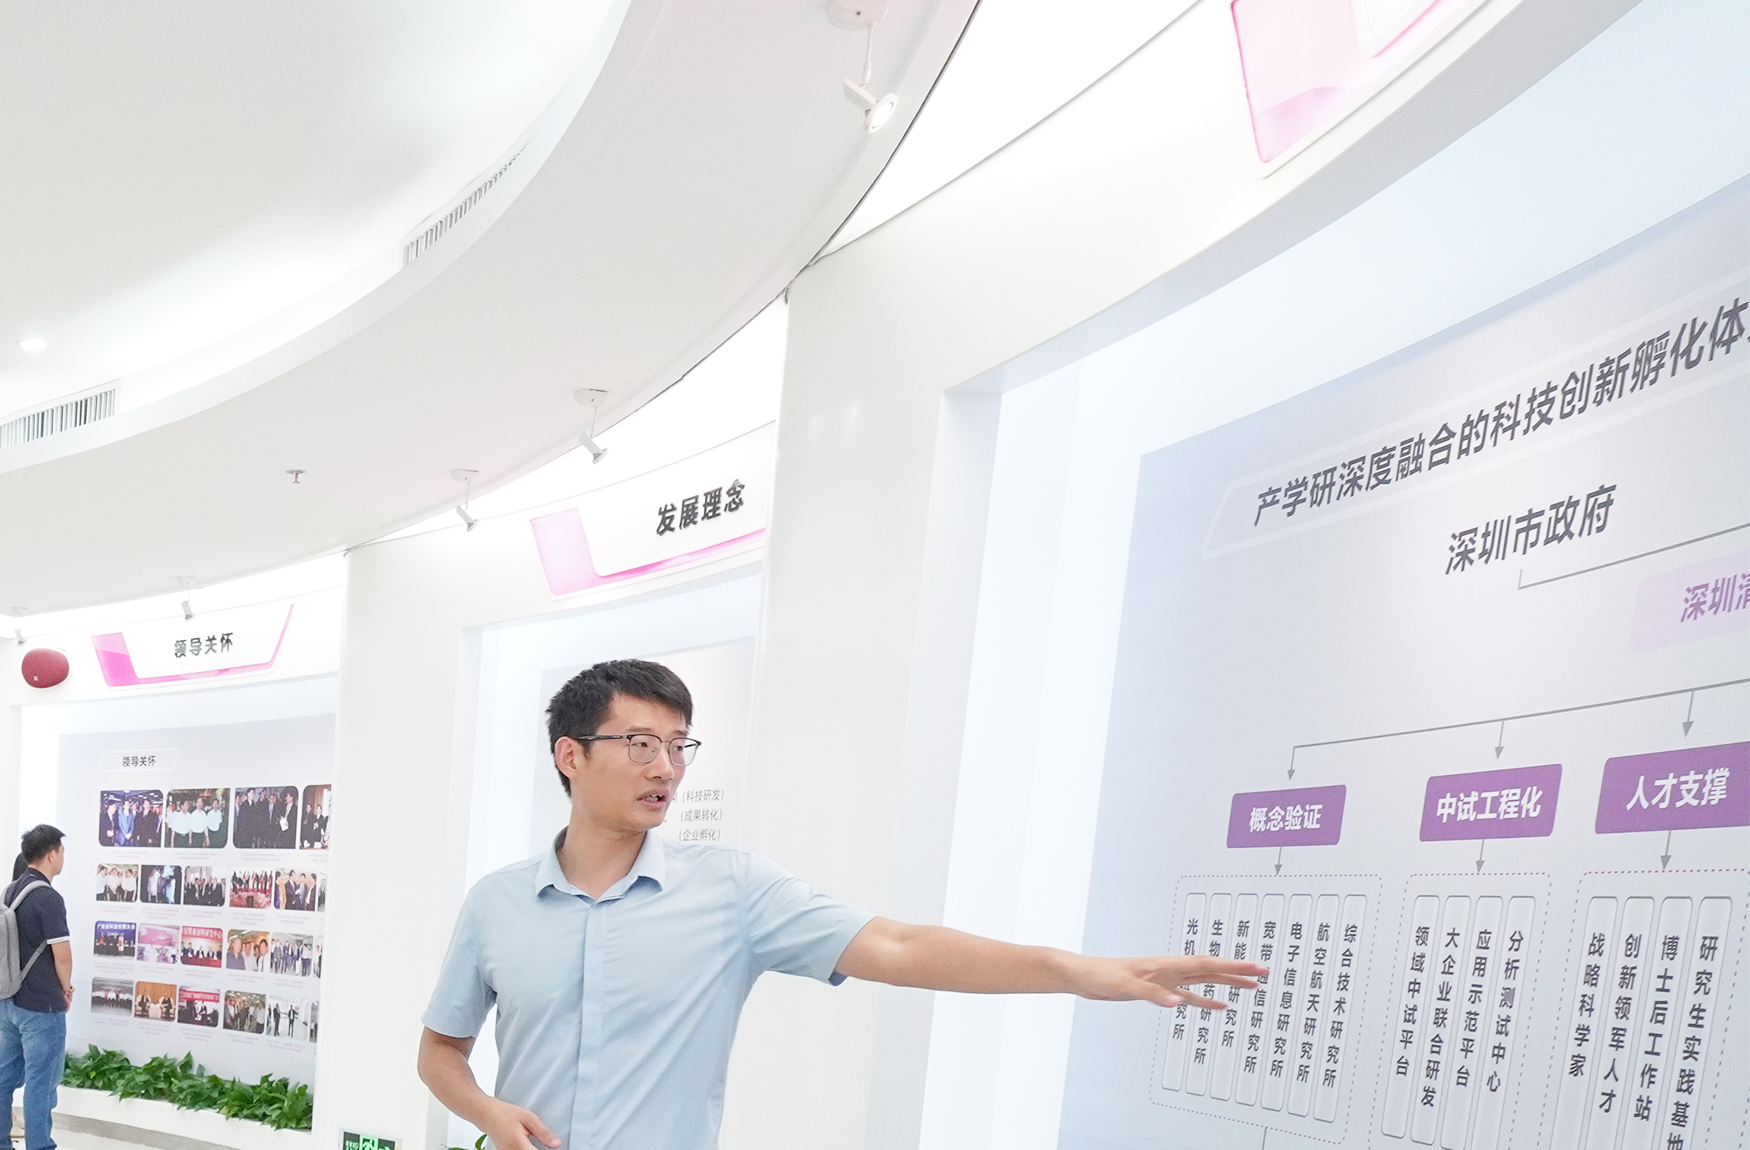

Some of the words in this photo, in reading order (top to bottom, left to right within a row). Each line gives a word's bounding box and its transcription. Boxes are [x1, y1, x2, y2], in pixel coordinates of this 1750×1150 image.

[1254, 297, 1750, 527] 产学研深度融合的科技创新孵化体
[656, 478, 746, 536] 发展理念
[1445, 484, 1617, 575] 深圳市政府
[174, 632, 234, 658] 领导关怀
[122, 755, 157, 767] 领导关怀
[1249, 804, 1323, 832] 概念验证
[1436, 785, 1543, 824] 中试工程化
[1626, 767, 1730, 811] 人才支撑
[1172, 918, 1200, 1041] 光机究所
[1193, 919, 1225, 1065] 生物药研究所
[1221, 920, 1251, 1048] 新能研究所
[1269, 921, 1304, 1079] 电子信息研究所
[1296, 922, 1332, 1084] 航空航天研究所
[1322, 923, 1359, 1089] 综合技术研究所
[1395, 925, 1431, 1077] 领域中试平台
[1420, 927, 1461, 1108] 大企业联合研发
[1455, 929, 1493, 1088] 应用示范平台
[1486, 930, 1525, 1093] 分析测试中心
[1568, 932, 1606, 1078] 战略科学家
[1598, 933, 1643, 1114] 创新领军人才
[1633, 934, 1681, 1122] 博士后工作站
